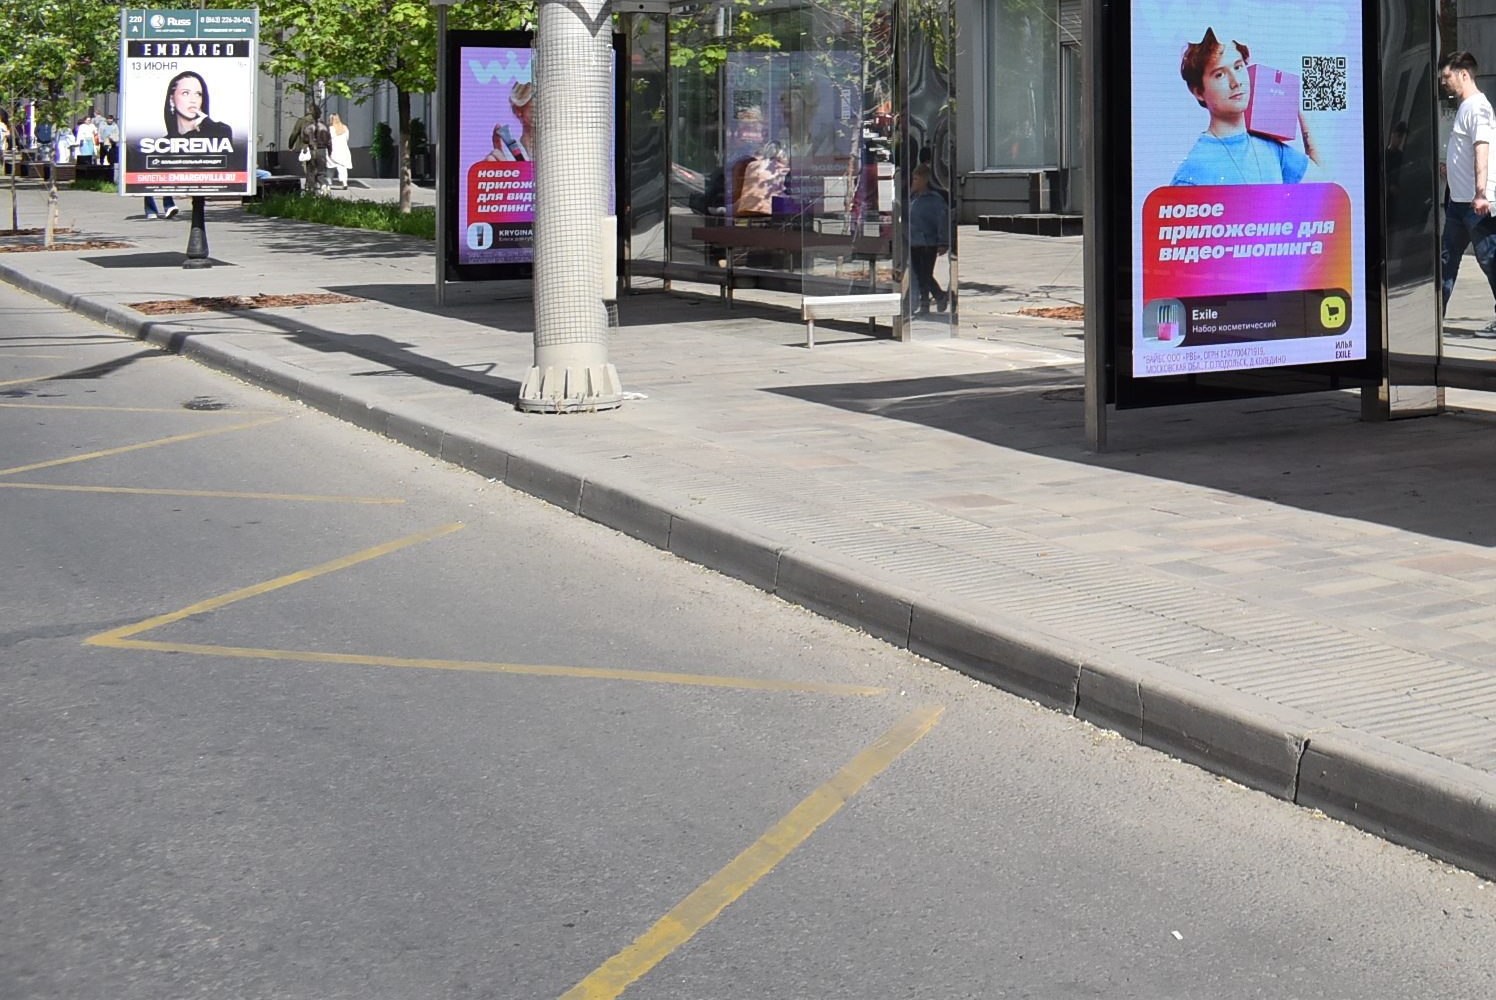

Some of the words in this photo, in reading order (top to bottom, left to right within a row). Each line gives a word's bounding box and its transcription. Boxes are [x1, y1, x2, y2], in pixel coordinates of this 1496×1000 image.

[167, 17, 191, 26] Russ
[144, 43, 234, 56] EMBARGO
[131, 62, 141, 70] 13
[144, 62, 178, 70] ИЮНЯ
[140, 137, 234, 153] SCIRENA
[477, 169, 520, 178] новое
[477, 192, 503, 203] для
[1159, 203, 1225, 219] новое
[1159, 222, 1294, 245] приложение
[1297, 220, 1335, 238] для
[1159, 240, 1323, 264] видео-шопинга
[1192, 309, 1218, 320] Exile
[1192, 324, 1217, 334] Набор
[1218, 321, 1277, 332] косметический
[1335, 341, 1352, 350] ИЛЬЯ
[1335, 350, 1351, 359] EXILE
